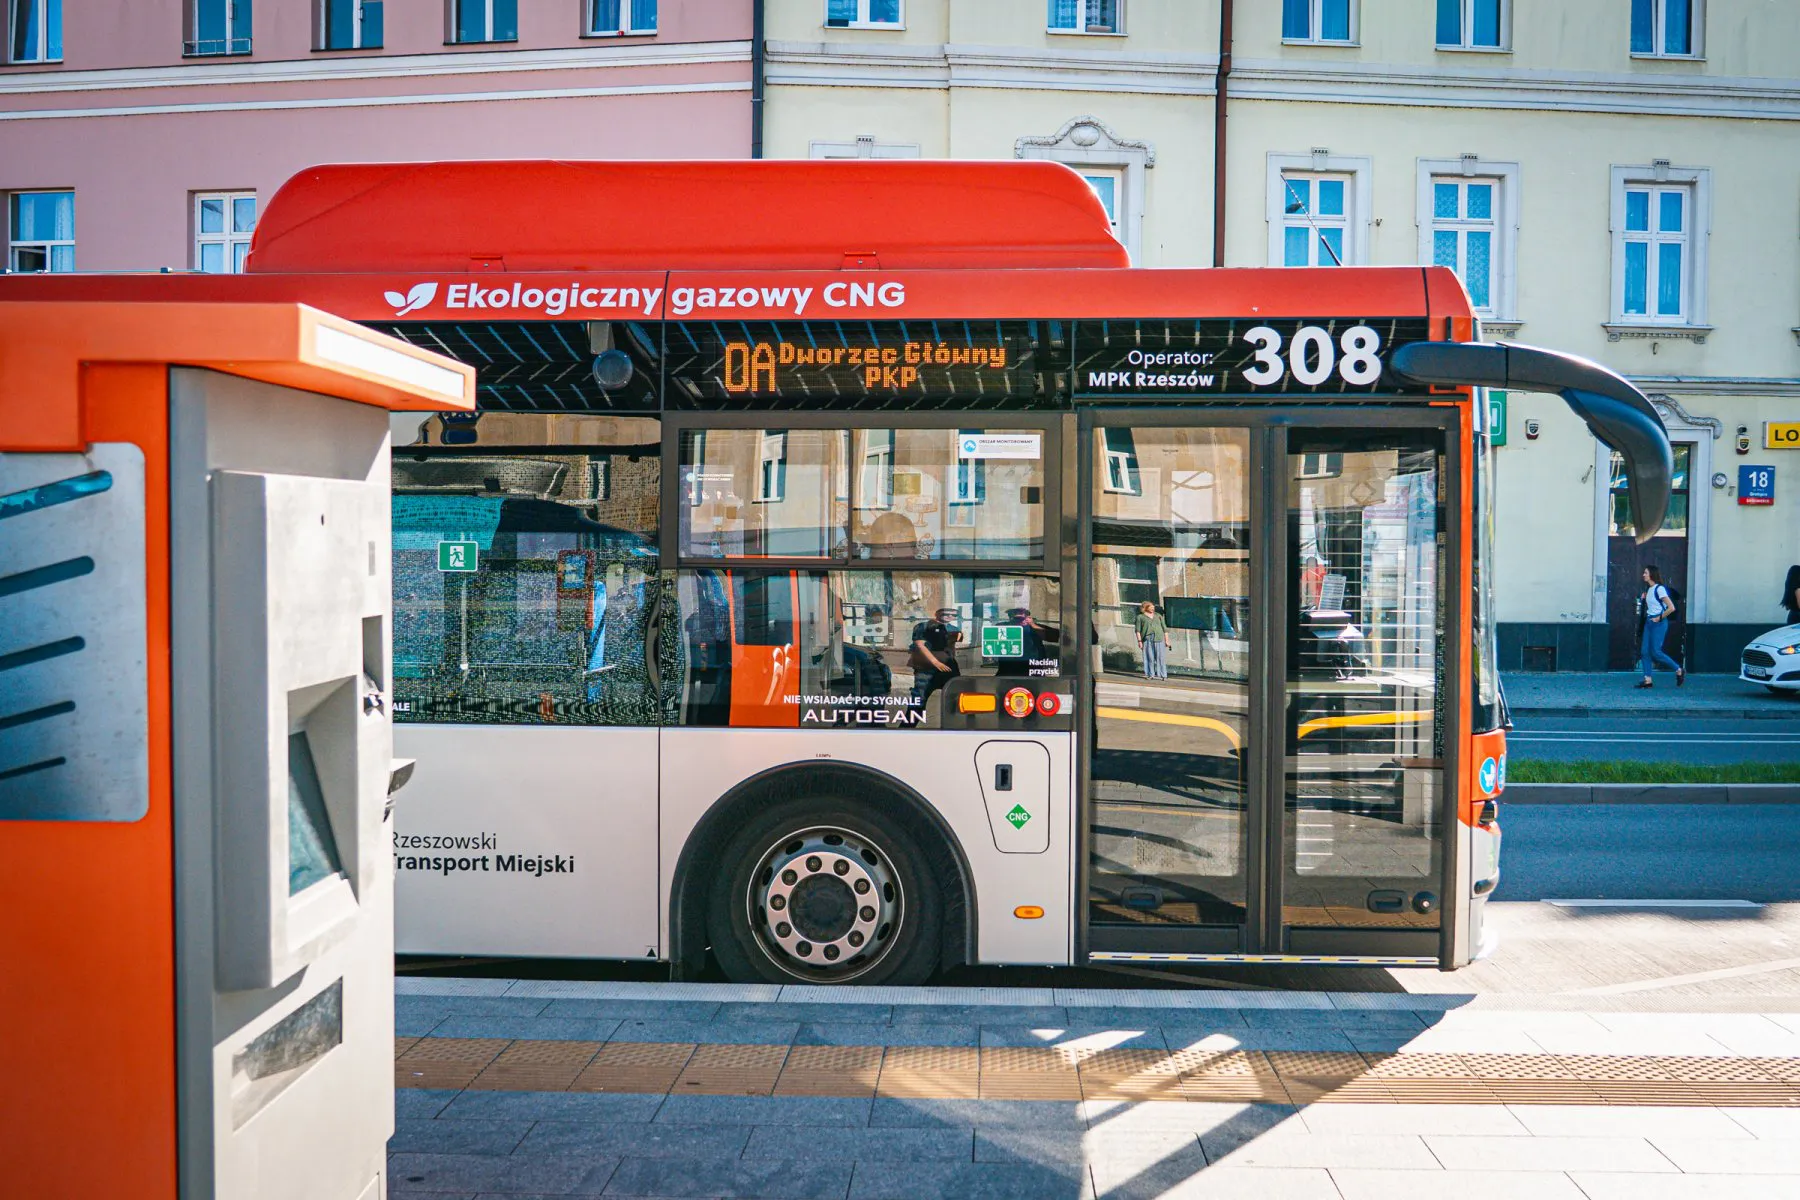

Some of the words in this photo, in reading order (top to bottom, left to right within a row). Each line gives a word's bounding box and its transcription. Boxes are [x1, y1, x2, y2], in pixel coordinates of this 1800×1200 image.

[446, 282, 663, 316] Ekologiczny
[671, 286, 814, 316] gazowy
[823, 282, 905, 308] CNG
[779, 342, 898, 364] Dworzec
[904, 342, 1006, 368] Główny
[1128, 350, 1214, 369] Operator:
[1242, 325, 1382, 386] 308
[865, 366, 917, 388] PKP
[1088, 372, 1131, 387] MPK
[1135, 370, 1214, 387] Rzeszów
[1749, 471, 1768, 487] 18
[1029, 658, 1058, 667] Naciśnij
[1029, 668, 1060, 676] przycisk
[783, 694, 801, 704] NIE
[802, 693, 853, 705] WSIADAĆ
[854, 695, 871, 705] PO
[872, 695, 921, 706] SYGNALE
[802, 709, 927, 724] AUTOSAN
[1008, 812, 1028, 821] CNG
[393, 853, 490, 876] ransport
[495, 854, 575, 877] Miejski
